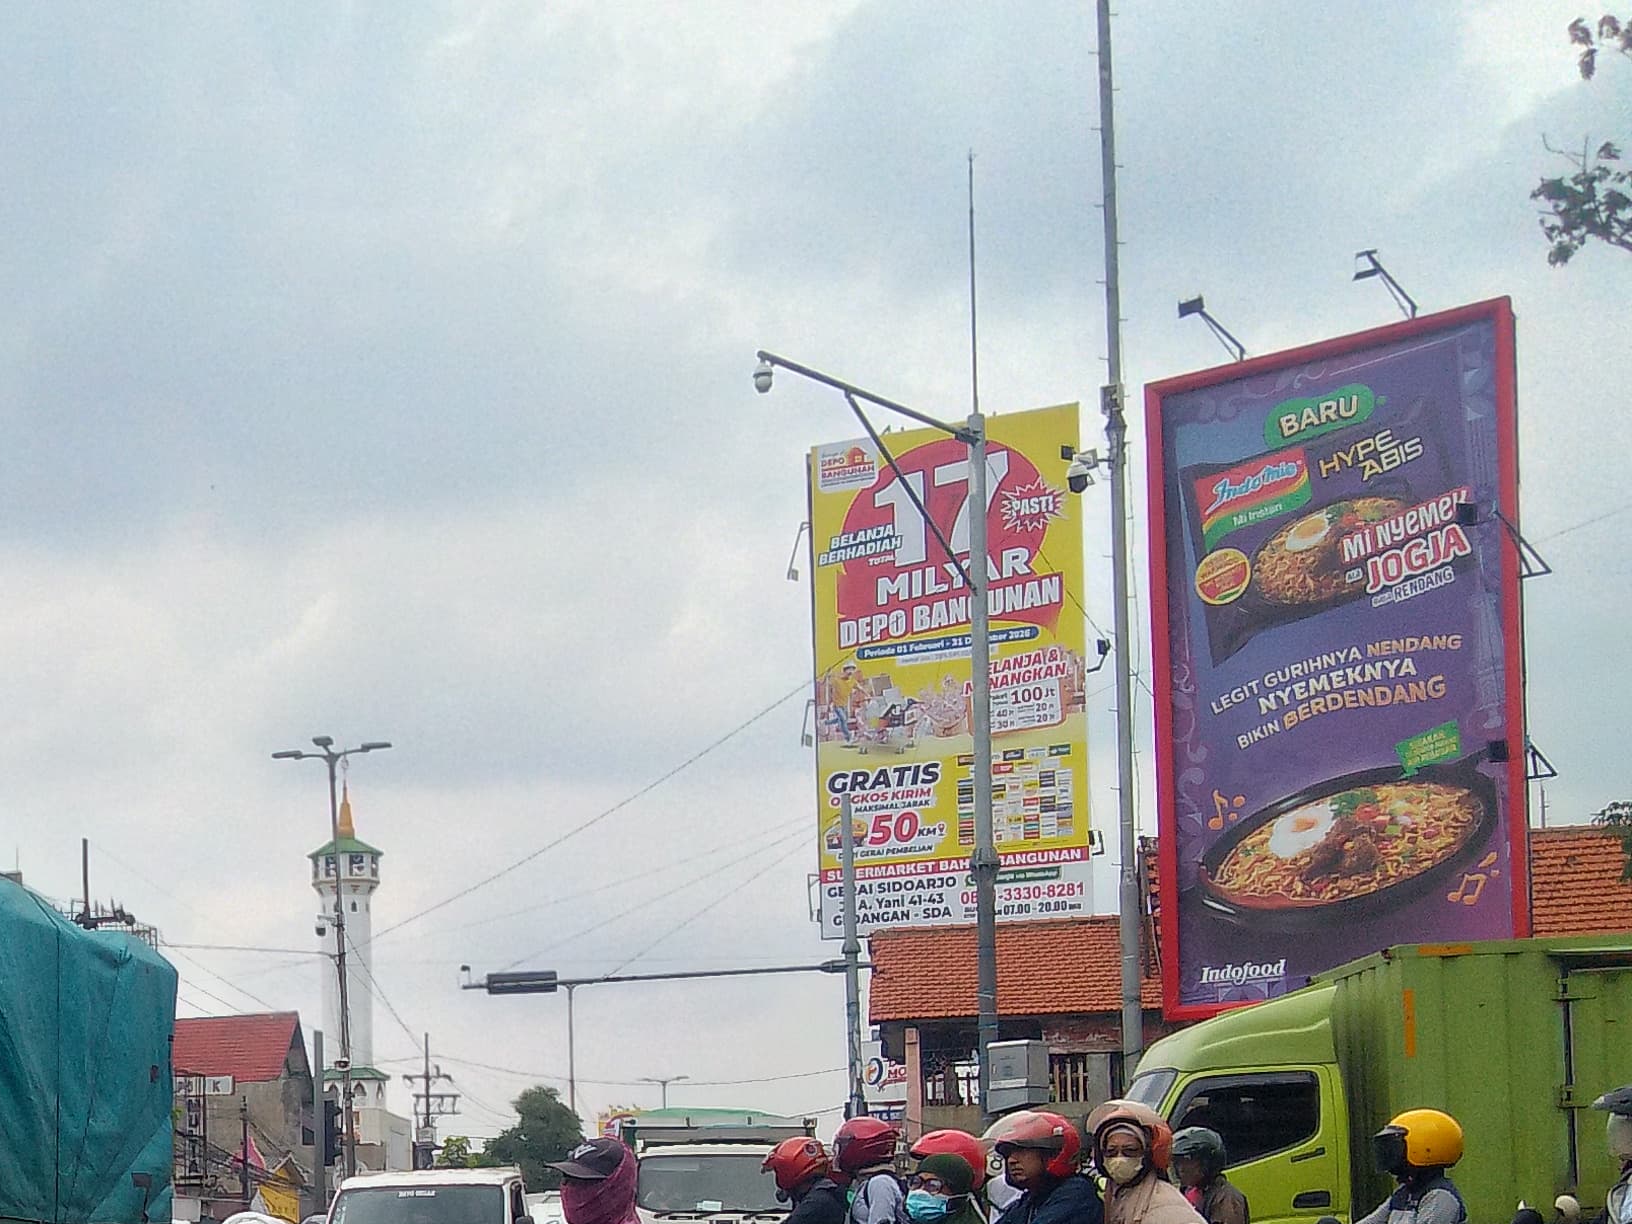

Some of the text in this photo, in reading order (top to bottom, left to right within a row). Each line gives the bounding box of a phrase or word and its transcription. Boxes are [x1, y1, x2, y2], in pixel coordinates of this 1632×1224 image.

[1280, 395, 1358, 437] BARU
[1319, 429, 1401, 478] HYPE
[1358, 437, 1423, 481] ABIS
[874, 450, 1009, 567] 17
[819, 536, 902, 566] BERHADIAH
[830, 524, 895, 549] BELANJA
[1368, 525, 1469, 591] JOGJA
[1394, 567, 1454, 600] RENDANG
[840, 576, 1060, 648] DEPO BANUNAN
[1211, 635, 1463, 715] LEGIT GURIHNYA NENDANG
[1258, 658, 1417, 715] NYEMEKNYA
[1011, 687, 1042, 705] 100
[1237, 675, 1447, 750] BIKIN BERDENDANG
[828, 763, 940, 794] GRATIS
[831, 788, 932, 807] OGKOS KIRIM
[869, 811, 919, 845] 50
[876, 894, 905, 909] Yani
[909, 892, 945, 906] 41-43
[877, 876, 957, 894] SIDOARJO
[923, 907, 952, 919] SDA
[1200, 959, 1286, 986] Indofood
